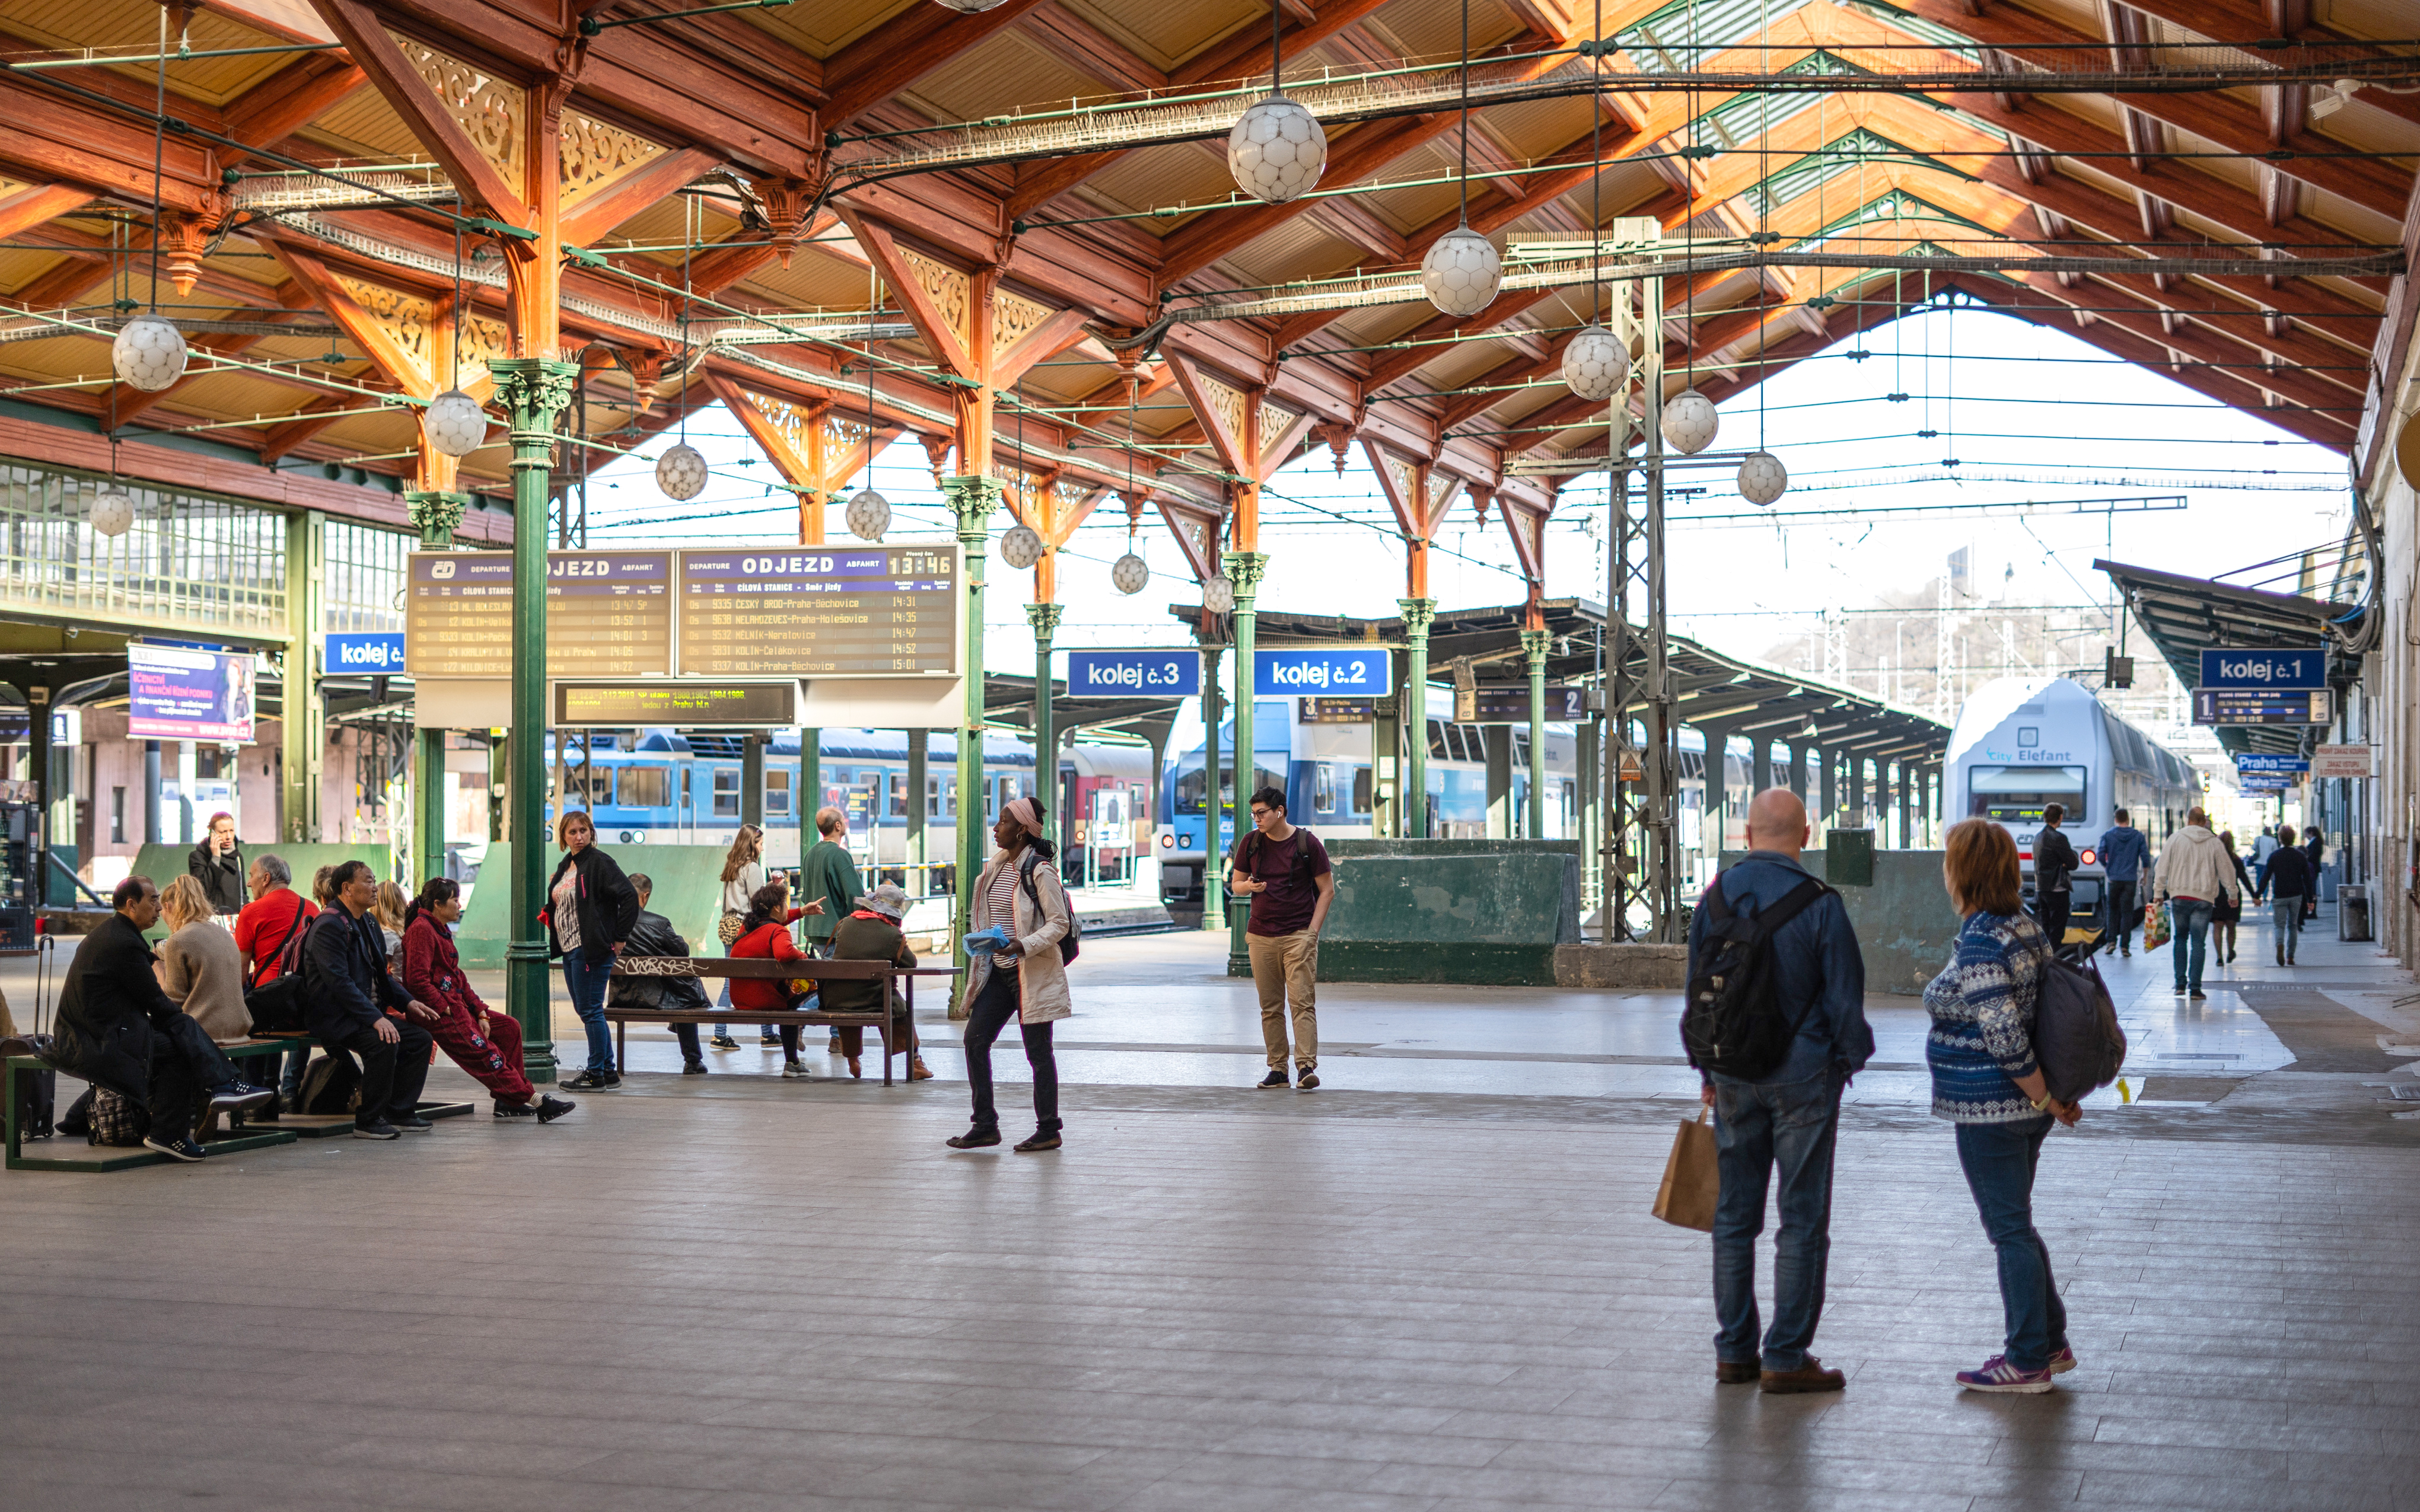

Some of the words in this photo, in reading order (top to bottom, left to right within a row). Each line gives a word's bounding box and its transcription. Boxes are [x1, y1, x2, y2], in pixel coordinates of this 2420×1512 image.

[547, 560, 610, 576] JEZD
[742, 557, 834, 573] ODJEZD
[890, 556, 950, 575] 13:46
[463, 586, 486, 595] CÍLOVÁ
[737, 583, 762, 592] CÍLOVÁ
[764, 583, 792, 592] STANICE
[825, 583, 841, 592] jízdy
[612, 600, 633, 611] 13:47
[689, 601, 699, 609] Os
[712, 599, 731, 609] 9335
[735, 599, 759, 609] ČESKÝ
[893, 596, 916, 607] 14:31
[611, 615, 633, 626] 13:52
[643, 615, 646, 626] 1
[689, 616, 699, 624] Os
[712, 614, 731, 624] 9638
[893, 612, 916, 622] 14:35
[611, 630, 632, 641] 14:01
[642, 630, 647, 641] 3
[712, 630, 731, 640] 9532
[893, 627, 916, 638] 14:47
[341, 642, 388, 666] kolej
[390, 647, 405, 662] č.
[610, 646, 633, 656] 14:05
[893, 643, 916, 654] 14:52
[610, 662, 633, 672] 14:22
[712, 661, 731, 671] 9337
[893, 659, 915, 669] 15:01
[2220, 659, 2272, 682] kolej
[2276, 659, 2301, 678] č.1
[1089, 663, 1142, 688] kolej
[1147, 662, 1180, 684] č.3
[1273, 661, 1329, 688] kolej
[1333, 661, 1366, 684] č.2
[139, 685, 144, 693] A
[189, 688, 213, 699] PODNIKU
[1566, 691, 1581, 714] 2.
[2201, 694, 2213, 716] 1.
[1987, 748, 2012, 762] City
[2019, 749, 2071, 761] Elefant
[2238, 757, 2278, 769] Praha
[2242, 777, 2269, 787] Praha
